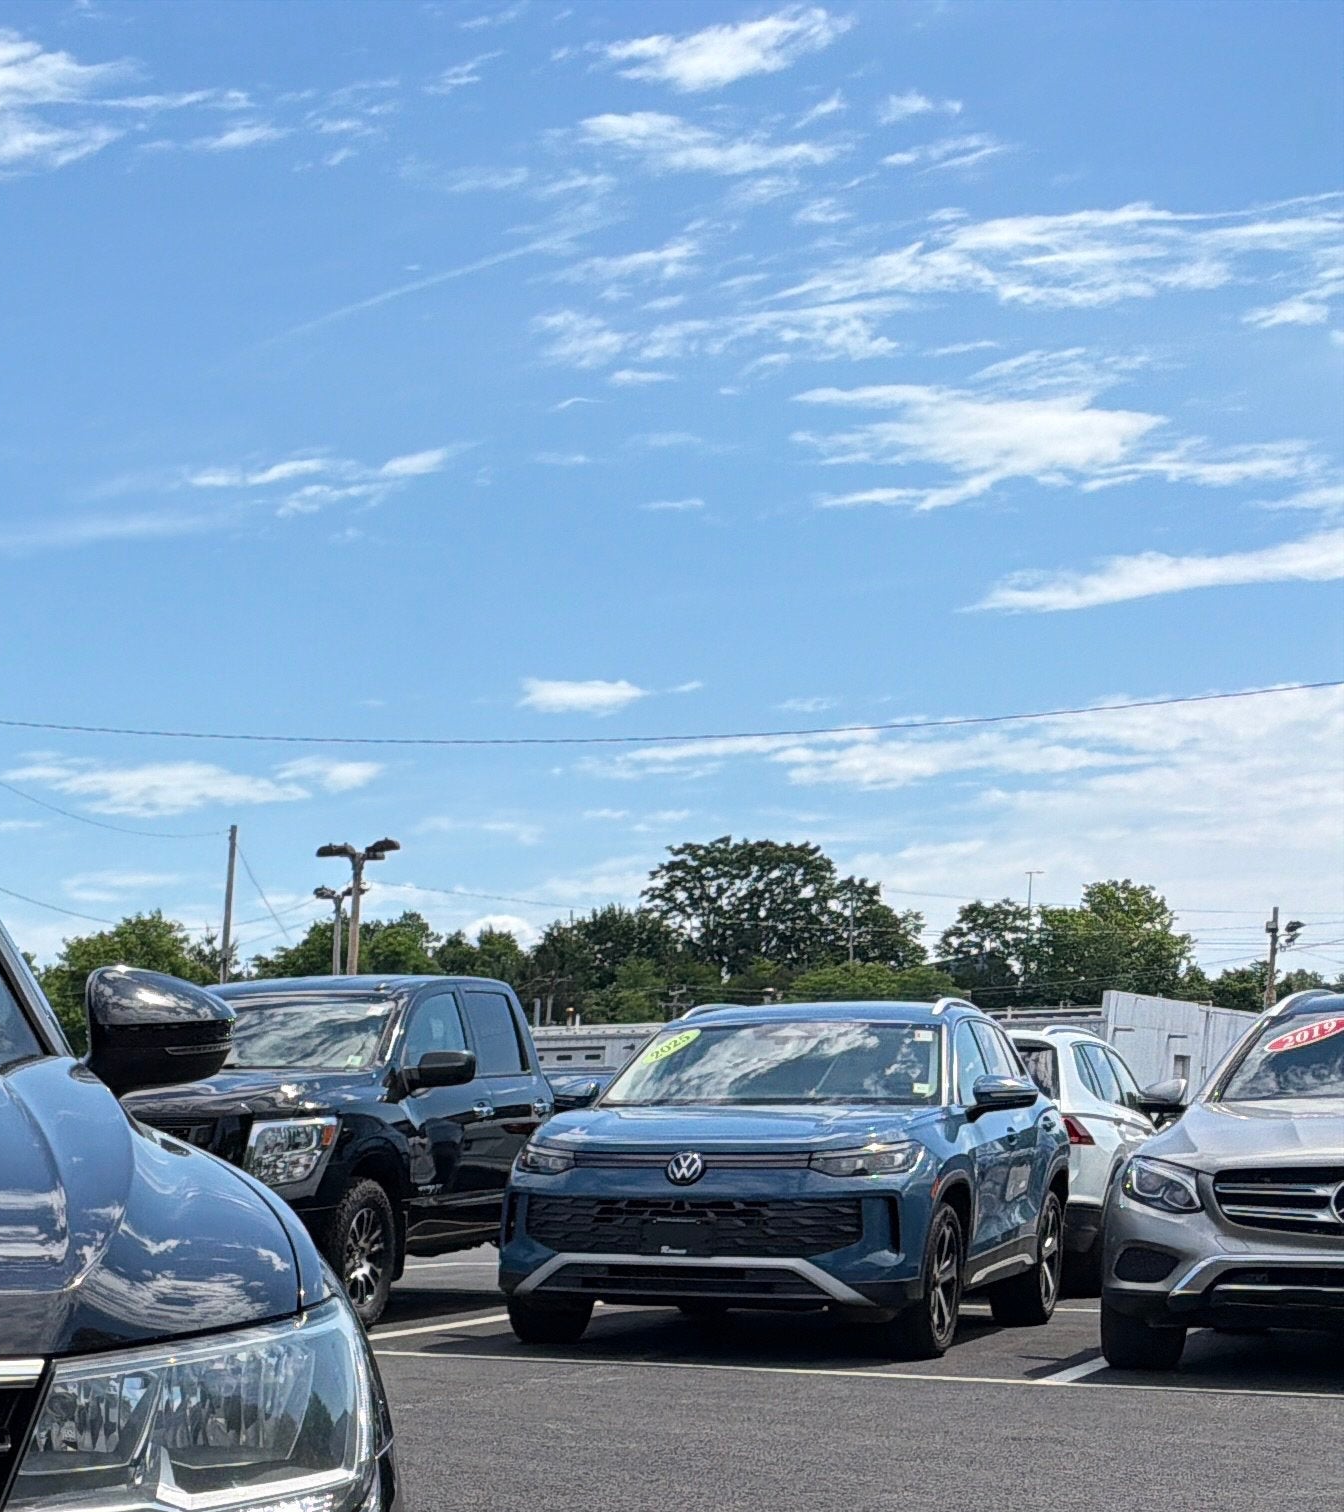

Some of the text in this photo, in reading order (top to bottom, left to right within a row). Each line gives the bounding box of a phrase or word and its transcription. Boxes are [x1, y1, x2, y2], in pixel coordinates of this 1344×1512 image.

[650, 1034, 691, 1059] 2025
[1282, 1020, 1337, 1049] 2019
[668, 1152, 702, 1182] VW
